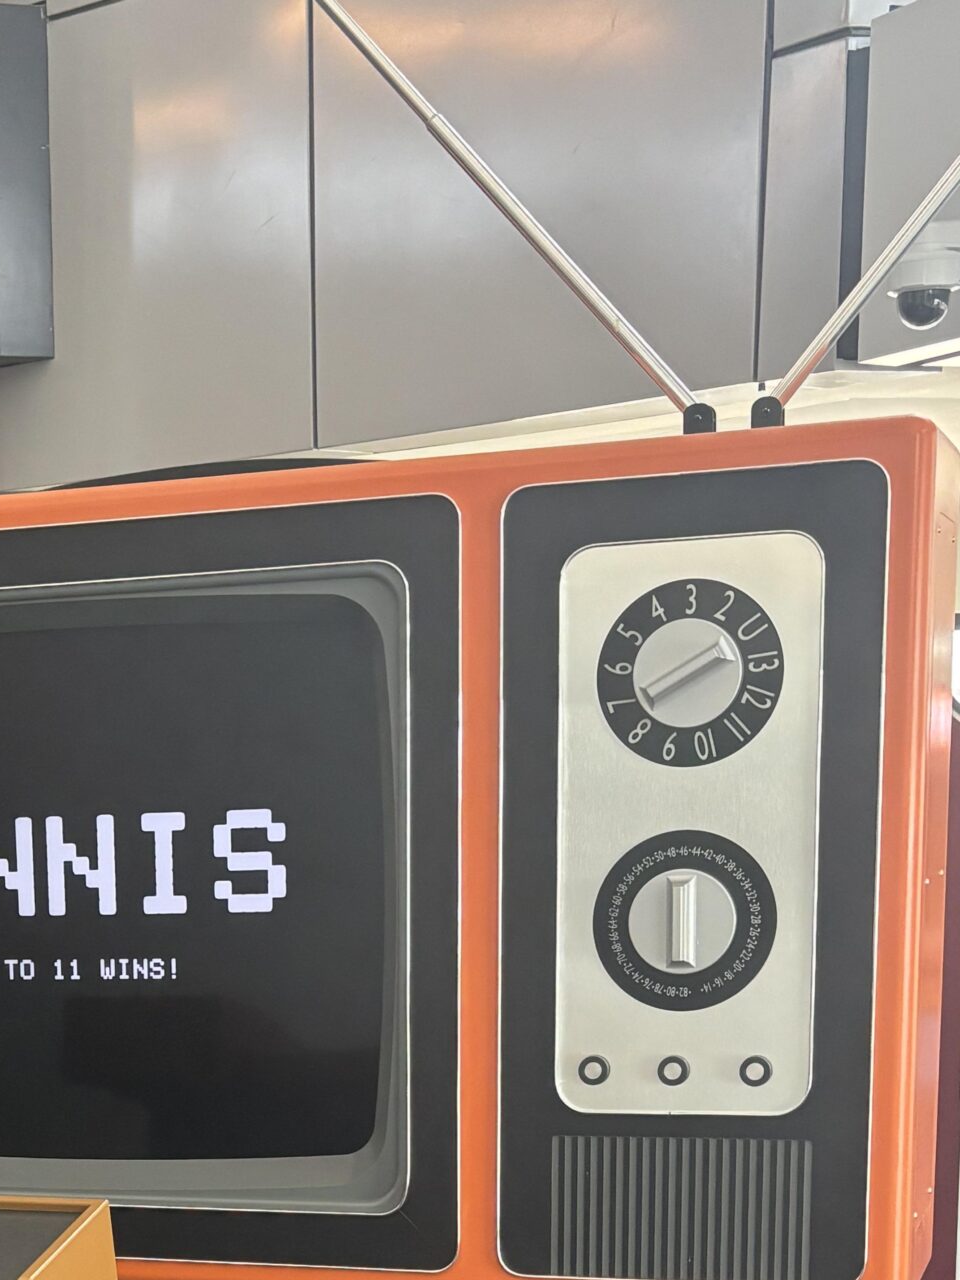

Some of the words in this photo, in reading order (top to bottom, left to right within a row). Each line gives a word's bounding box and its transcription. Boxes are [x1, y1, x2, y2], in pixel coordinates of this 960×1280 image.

[651, 595, 667, 621] 4
[685, 584, 696, 614] 3
[713, 590, 735, 621] 2
[617, 623, 642, 646] 5
[737, 612, 768, 641] U
[604, 662, 632, 675] 6
[747, 651, 779, 673] 13
[606, 699, 637, 714] 7
[741, 684, 775, 709] 12
[628, 718, 651, 744] 8
[723, 712, 751, 742] 11
[662, 732, 677, 761] 9
[694, 728, 717, 761] 10
[5, 959, 35, 981] TO
[53, 959, 81, 981] 11
[100, 958, 178, 981] WINS!
